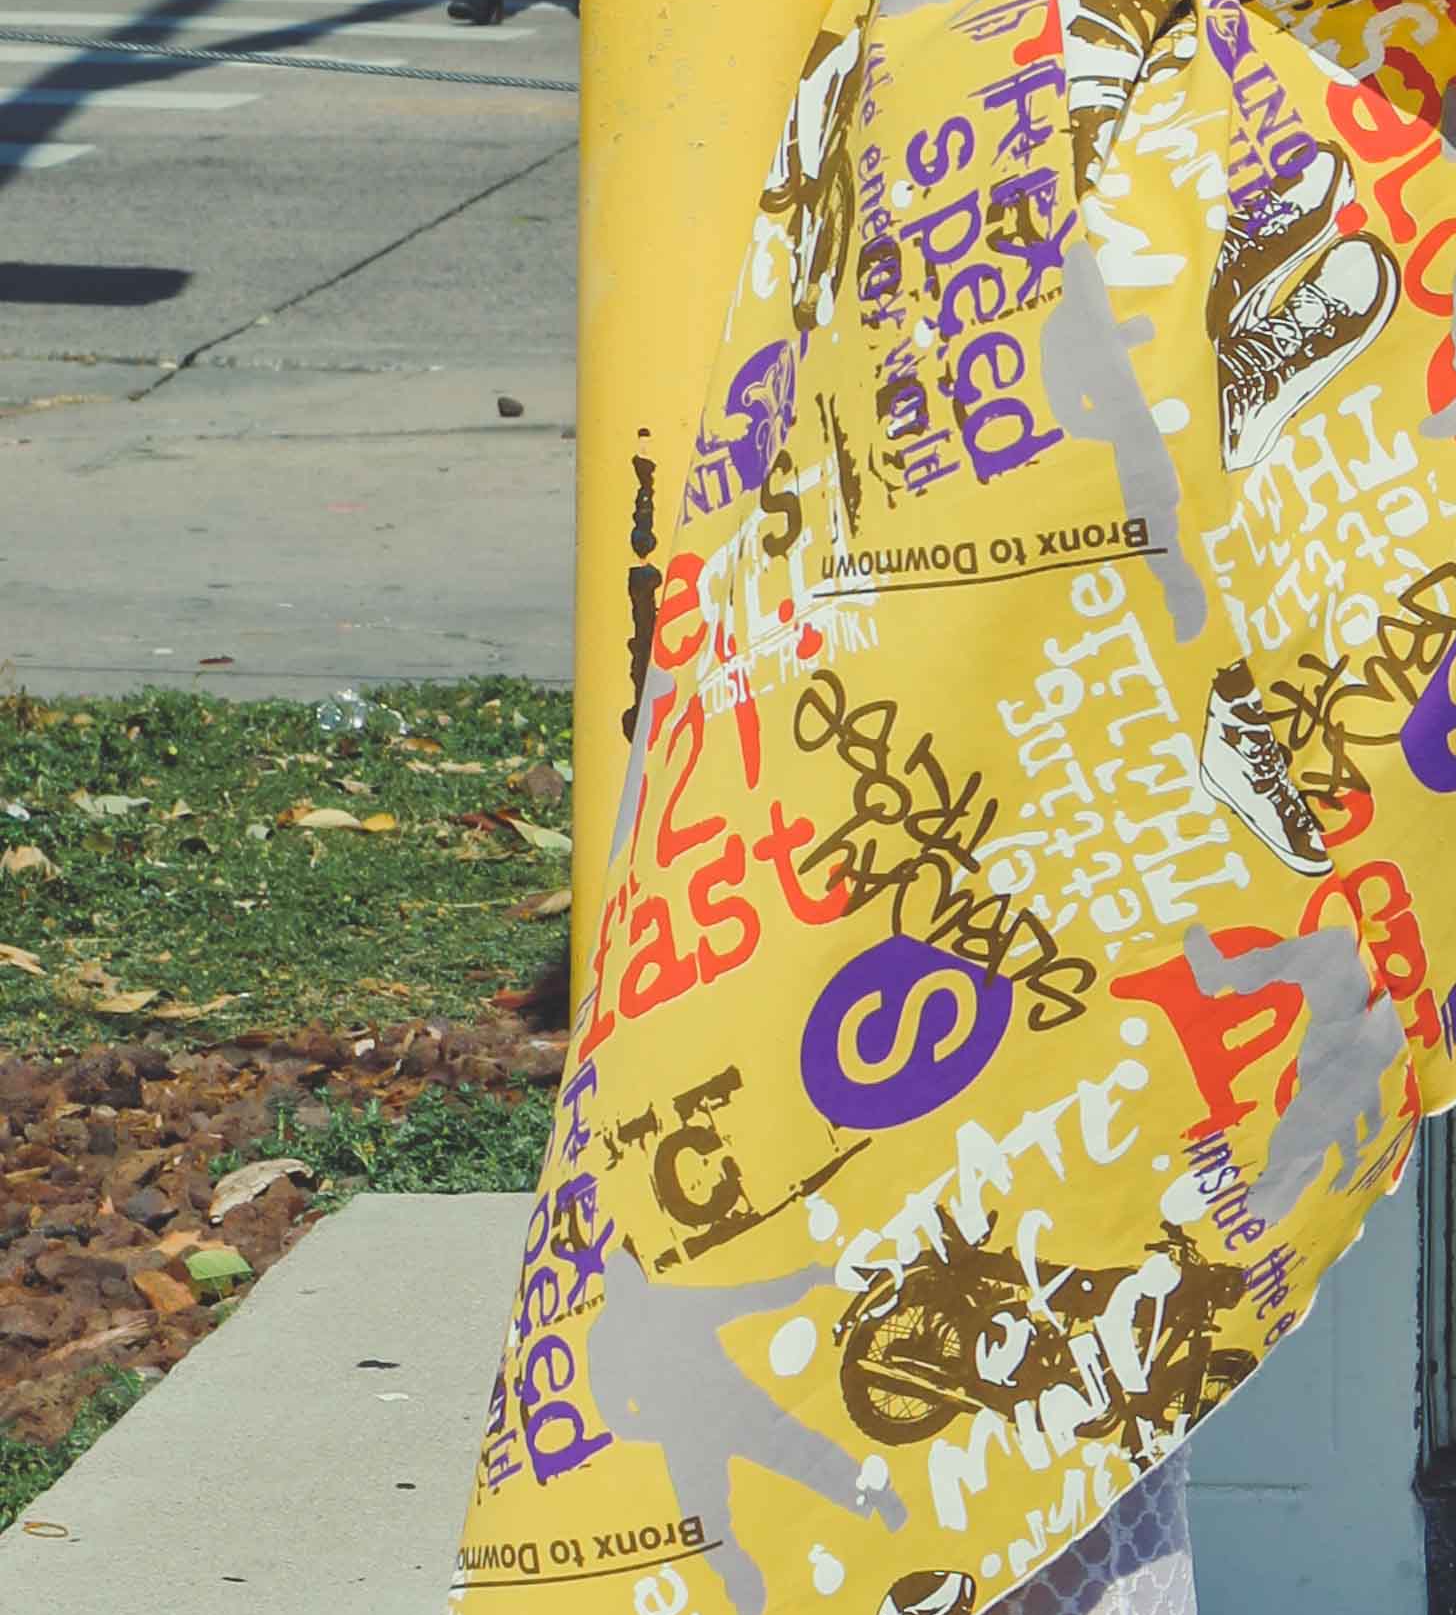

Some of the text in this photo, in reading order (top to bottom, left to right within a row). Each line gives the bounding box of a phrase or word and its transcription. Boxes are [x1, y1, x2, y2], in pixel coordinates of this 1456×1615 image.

[906, 114, 1064, 483] speed
[991, 537, 1026, 567] to
[1037, 518, 1149, 556] Bronx
[596, 1515, 706, 1571] Bronx
